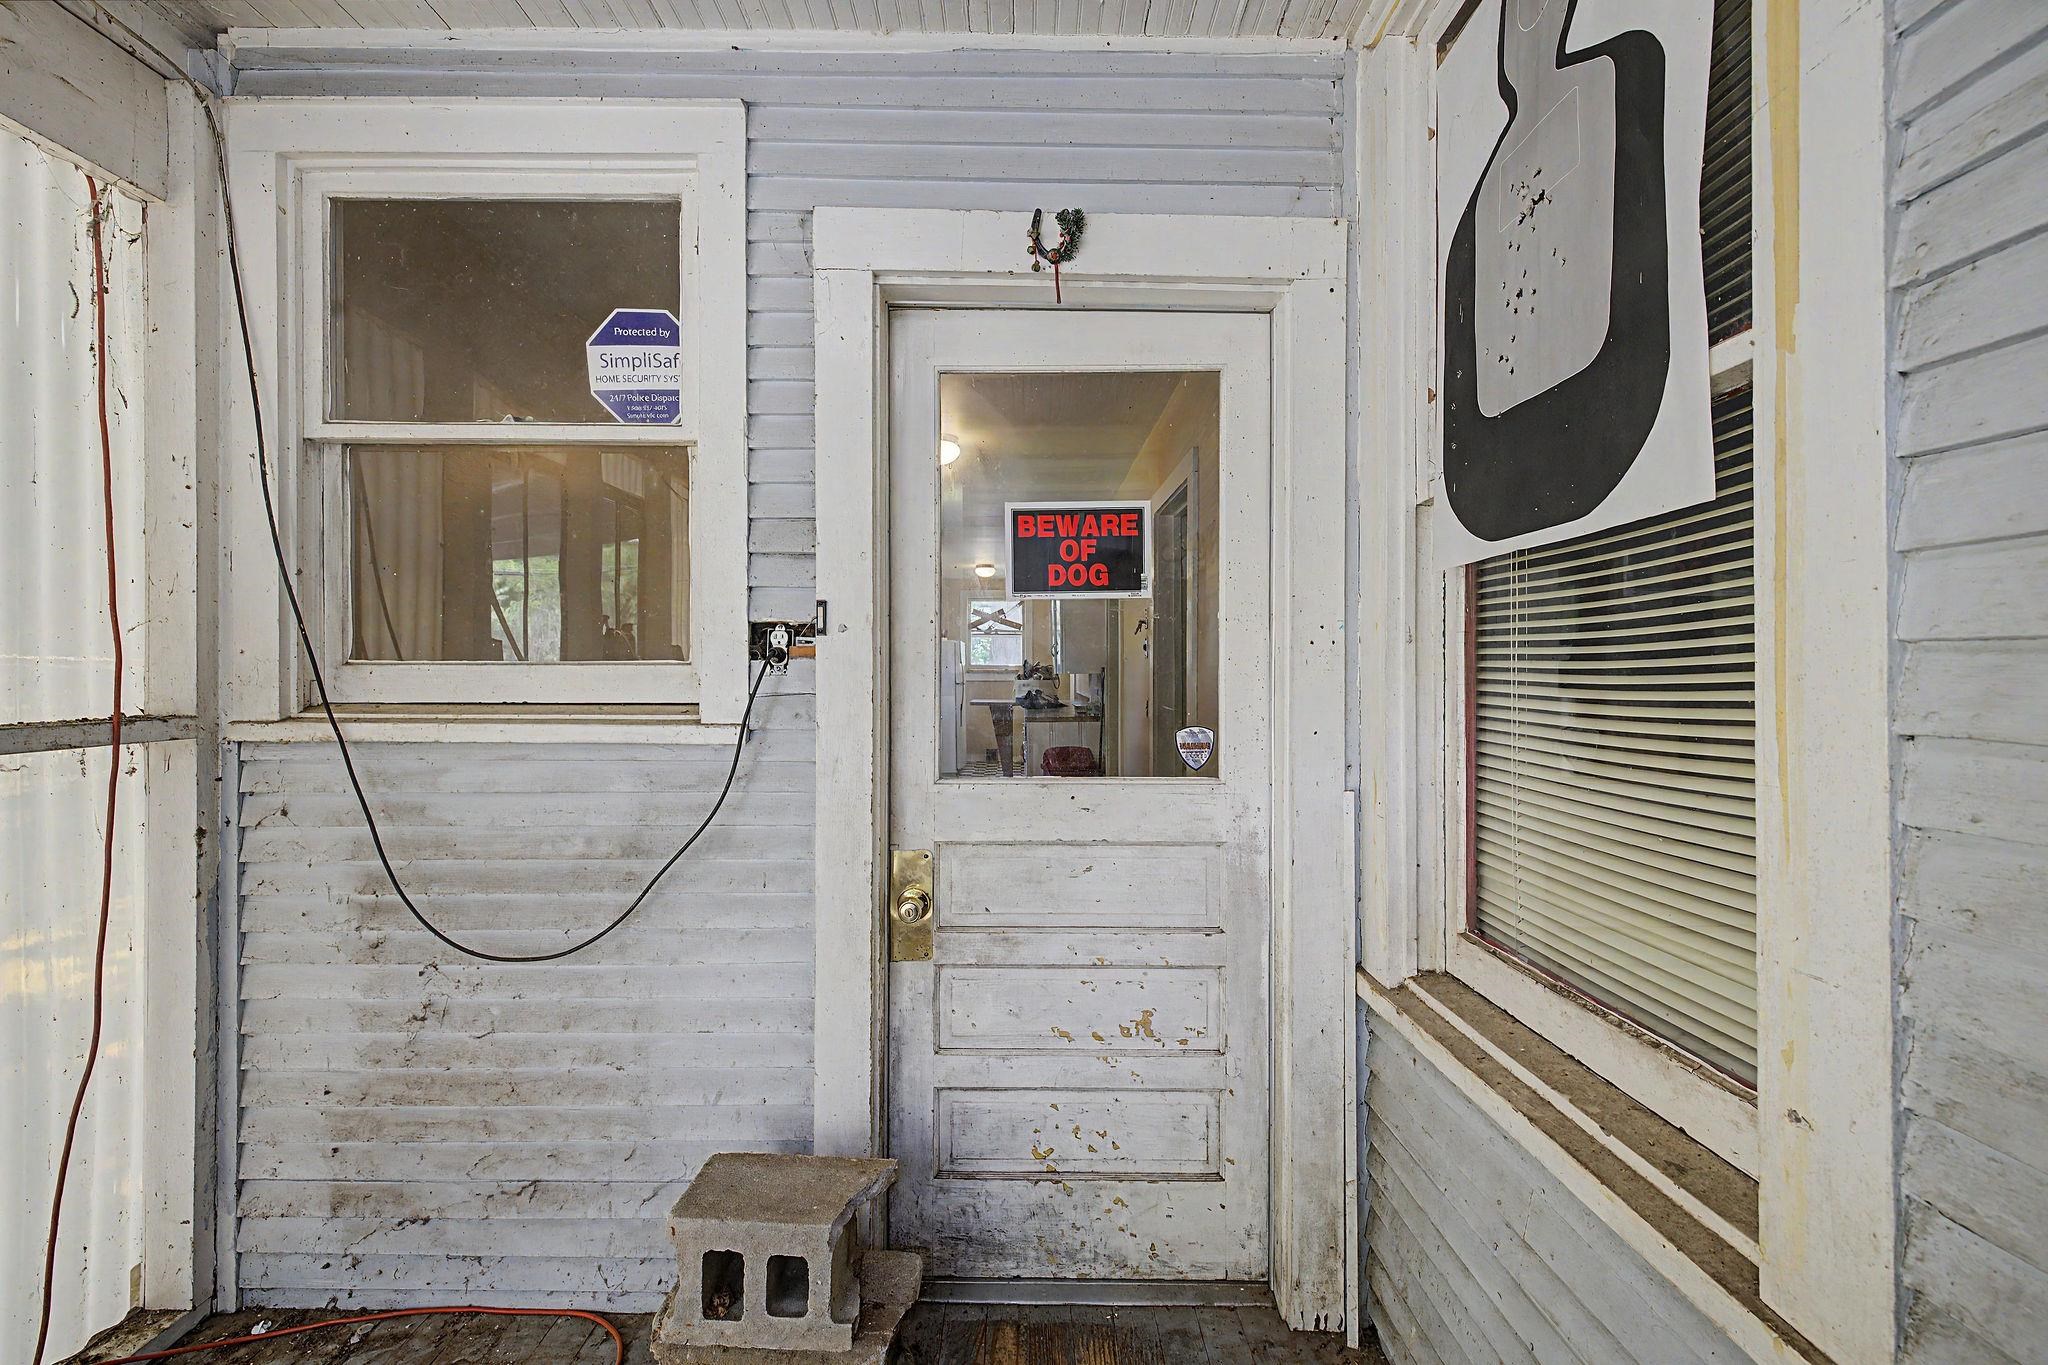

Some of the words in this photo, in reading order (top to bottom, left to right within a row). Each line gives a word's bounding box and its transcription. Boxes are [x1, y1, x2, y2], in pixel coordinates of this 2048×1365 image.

[614, 328, 657, 337] Protected
[659, 327, 671, 339] by
[595, 375, 620, 383] HOME
[622, 375, 661, 383] SECURITY
[609, 394, 626, 402] 24/7
[627, 394, 650, 402] Police
[1017, 514, 1139, 537] BEWARE
[1059, 539, 1097, 562] OF
[1048, 563, 1109, 587] DOG
